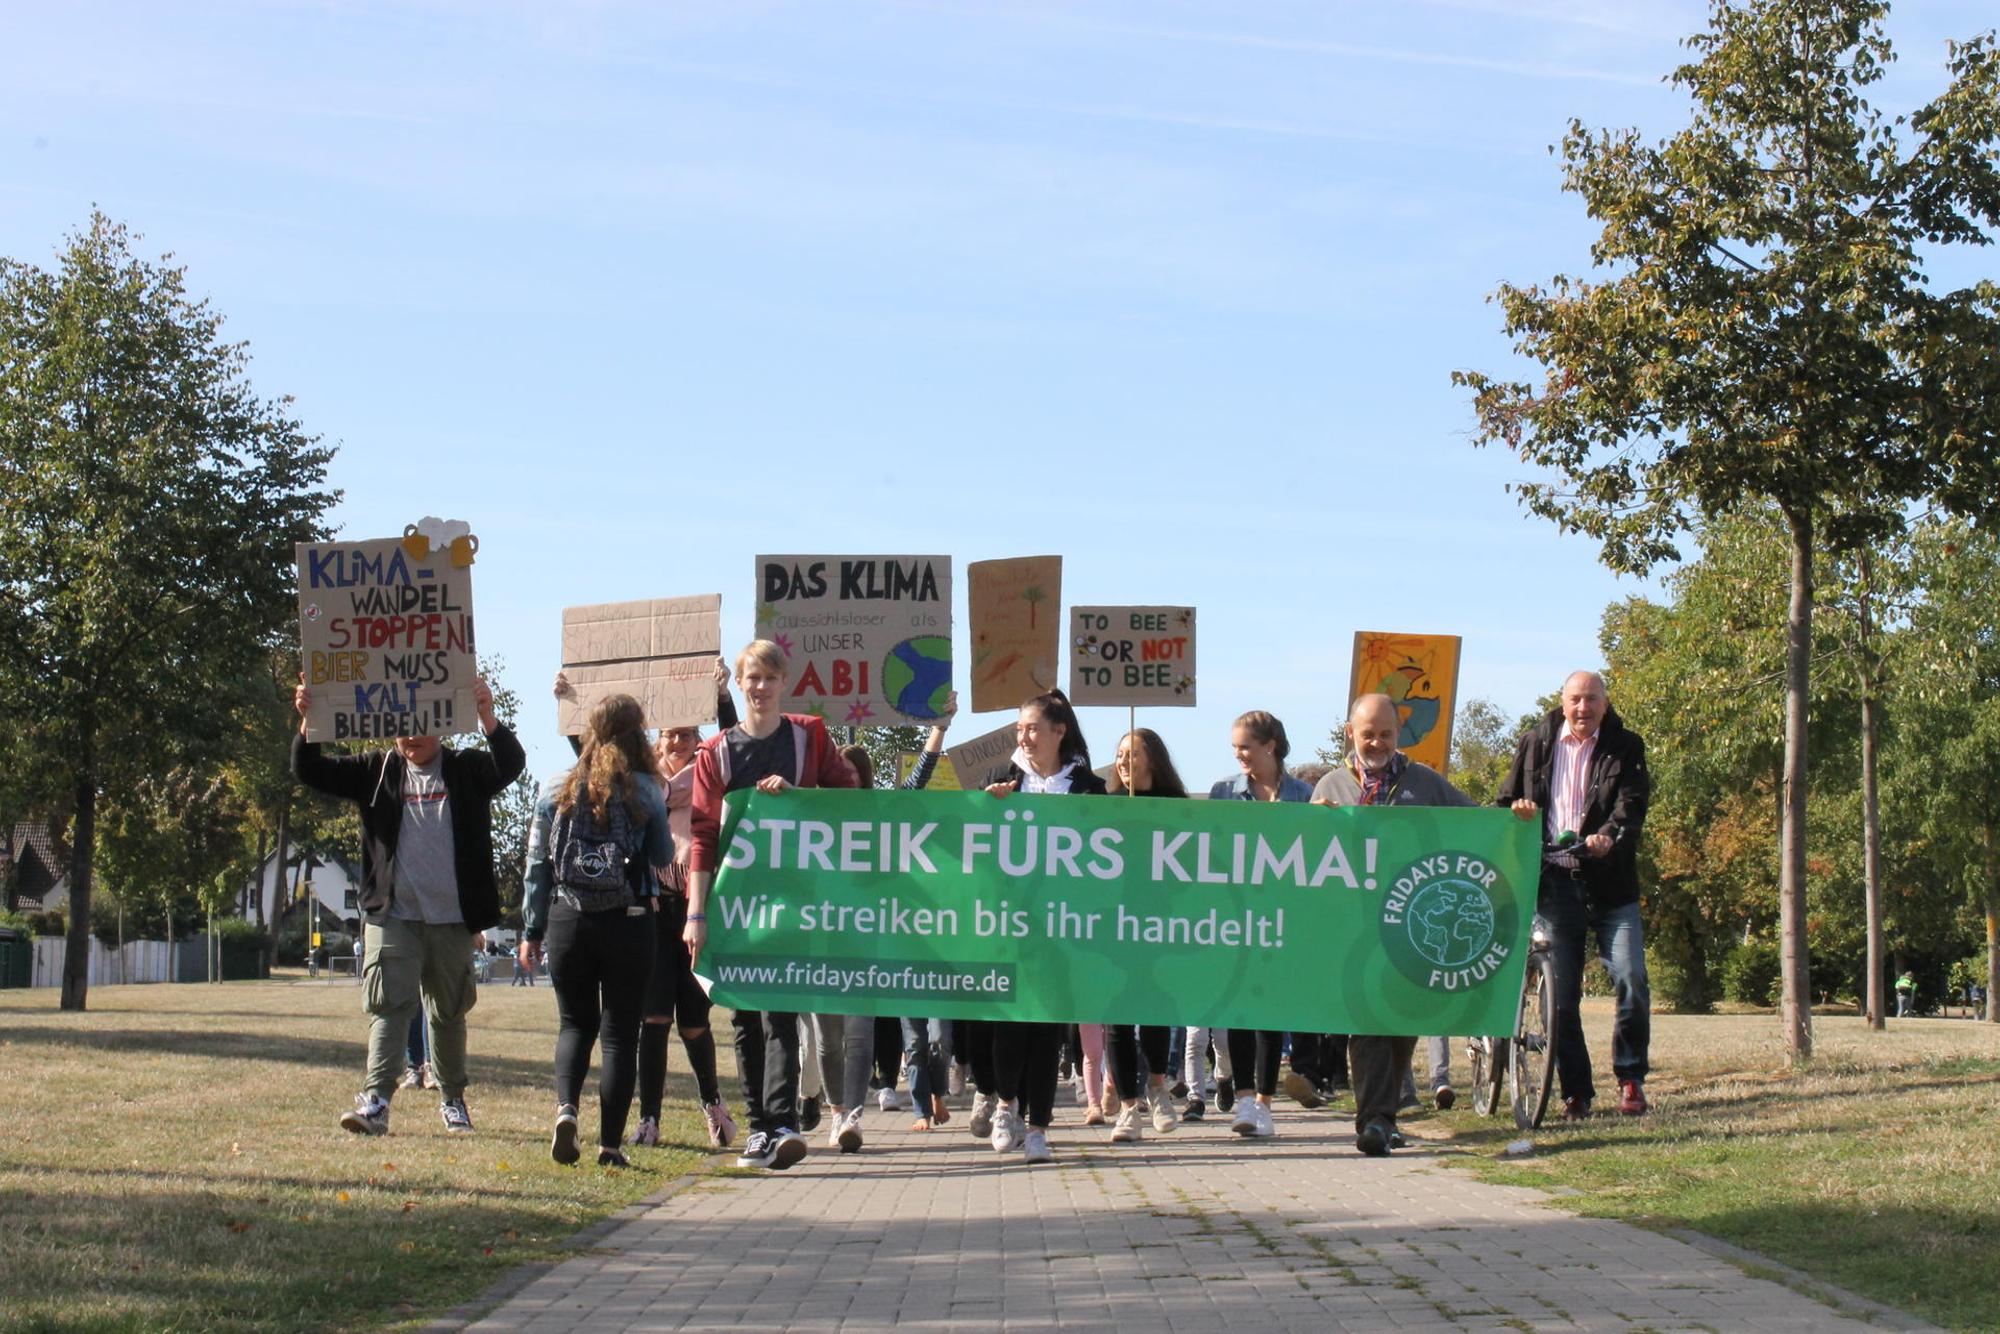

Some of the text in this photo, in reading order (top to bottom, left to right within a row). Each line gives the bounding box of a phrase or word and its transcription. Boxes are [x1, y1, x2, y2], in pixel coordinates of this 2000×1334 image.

[764, 562, 827, 602] DAS
[839, 560, 940, 602] KLIMA
[351, 583, 461, 616] WANDEL
[328, 613, 474, 654] STOPPEN!
[911, 614, 938, 627] als
[1079, 613, 1167, 631] TO BEE
[803, 634, 865, 654] UNSER
[1100, 636, 1188, 662] OR NOT
[311, 650, 449, 685] BIER MUSS
[791, 659, 869, 697] ABI
[1079, 664, 1171, 687] TO BEE
[355, 682, 421, 713] KALT
[725, 810, 1378, 890] STREIK FÜRS KLIMA!
[1384, 855, 1497, 924] FRIDAYS FOR
[719, 894, 1285, 949] Wir streiken bis ihr handelt!
[718, 962, 1011, 993] www.fridaysforfuture.de
[1429, 942, 1508, 990] FUTURE
